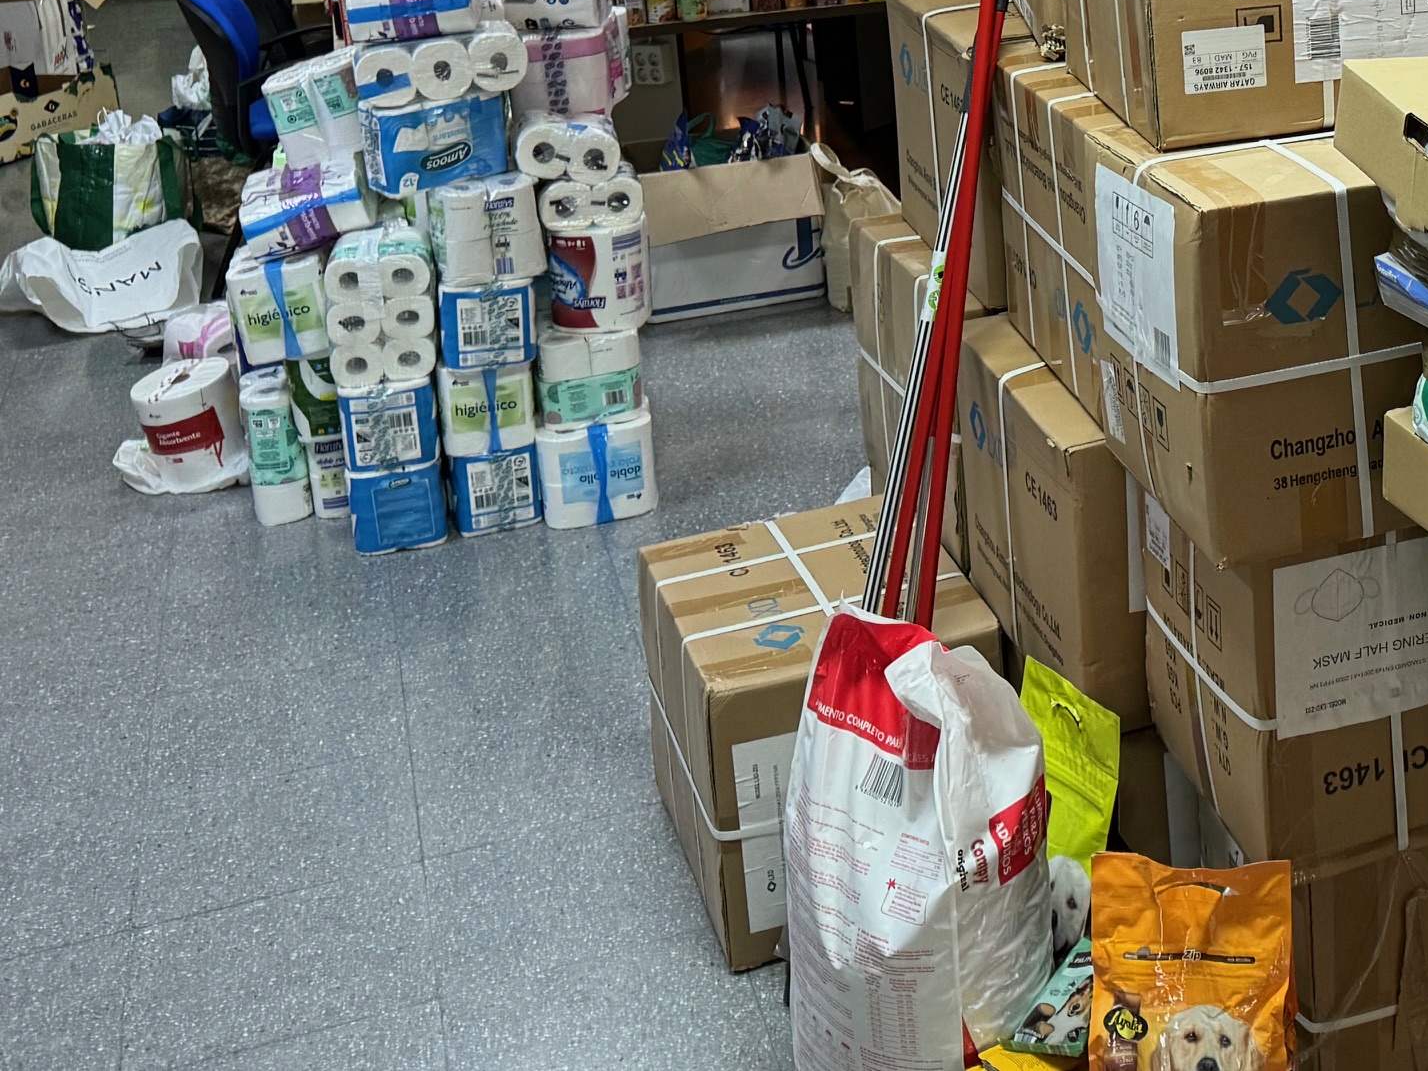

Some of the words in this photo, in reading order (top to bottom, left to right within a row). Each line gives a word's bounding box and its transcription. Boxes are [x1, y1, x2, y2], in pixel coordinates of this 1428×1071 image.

[1214, 53, 1233, 62] MAD
[1241, 50, 1257, 58] PVG
[1193, 81, 1228, 92] AIRWAYS
[1229, 77, 1256, 88] QATAR
[426, 144, 470, 171] Amoos
[1270, 428, 1357, 461] Changzho
[609, 463, 641, 481] doble
[1273, 476, 1288, 491] 38
[1290, 464, 1358, 488] Hengcheng
[1037, 485, 1058, 521] 1463
[715, 541, 744, 567] 1463
[1312, 649, 1351, 670] MASK
[1354, 641, 1389, 660] HALF
[846, 712, 885, 742] COMPLETO
[1323, 757, 1386, 796] 1463
[970, 838, 989, 885] Compy
[995, 821, 1012, 876] ADULTOS
[955, 849, 970, 892] original
[1181, 948, 1202, 962] Zip
